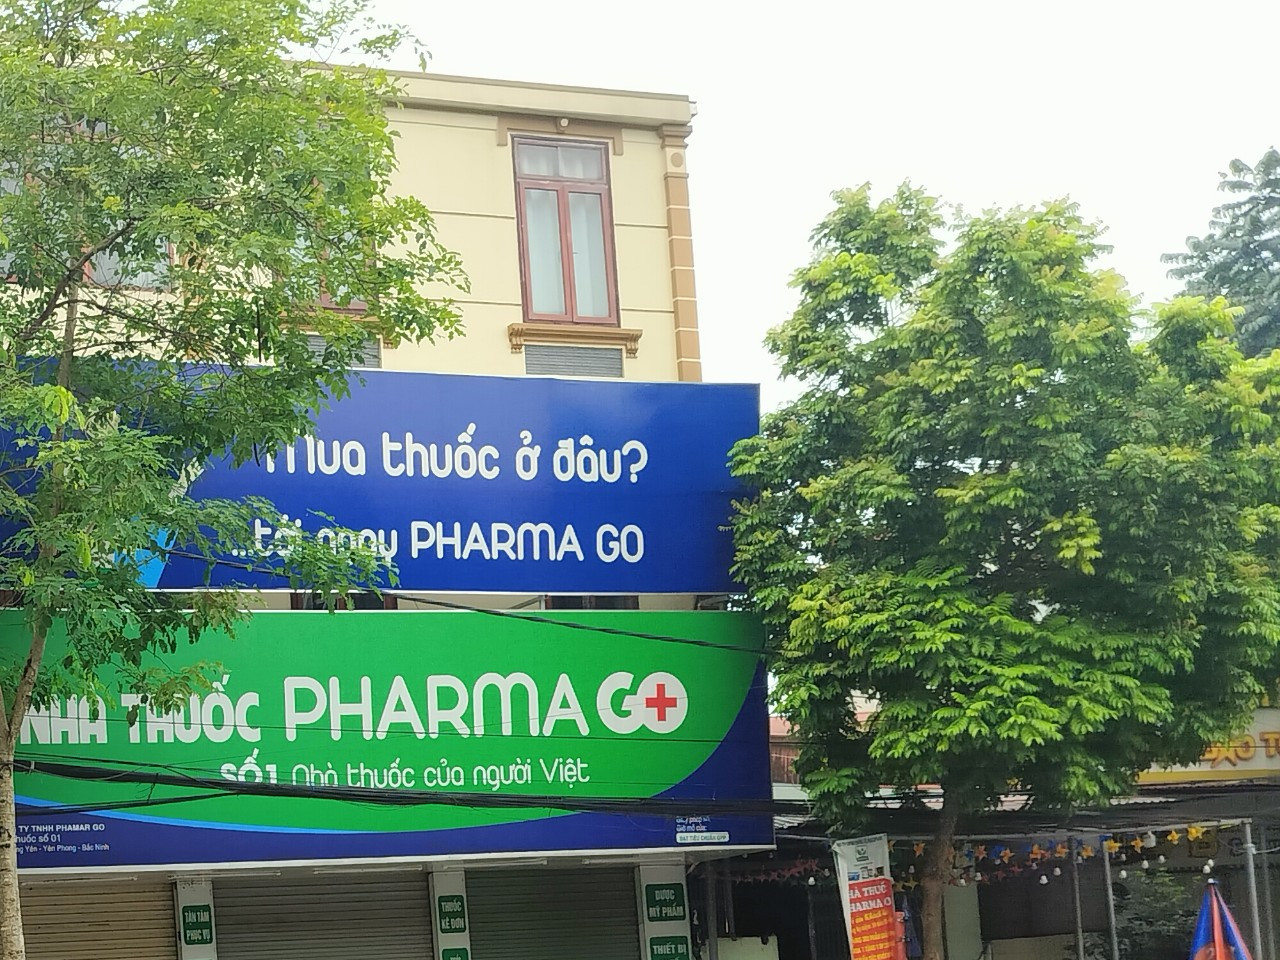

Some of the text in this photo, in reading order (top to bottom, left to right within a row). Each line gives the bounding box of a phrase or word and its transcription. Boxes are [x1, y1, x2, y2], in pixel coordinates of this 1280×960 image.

[382, 422, 500, 479] thuốc
[515, 430, 541, 481] ở
[553, 435, 649, 483] đâu?
[410, 520, 585, 562] PHARMA
[596, 523, 645, 562] GO
[121, 674, 261, 744] THUỐC
[283, 672, 590, 742] PHARMA
[596, 671, 689, 734] GO
[346, 757, 415, 789] thuốc
[423, 758, 465, 787] của
[473, 757, 531, 791] người
[539, 757, 590, 788] Việt
[31, 824, 55, 833] TNHH
